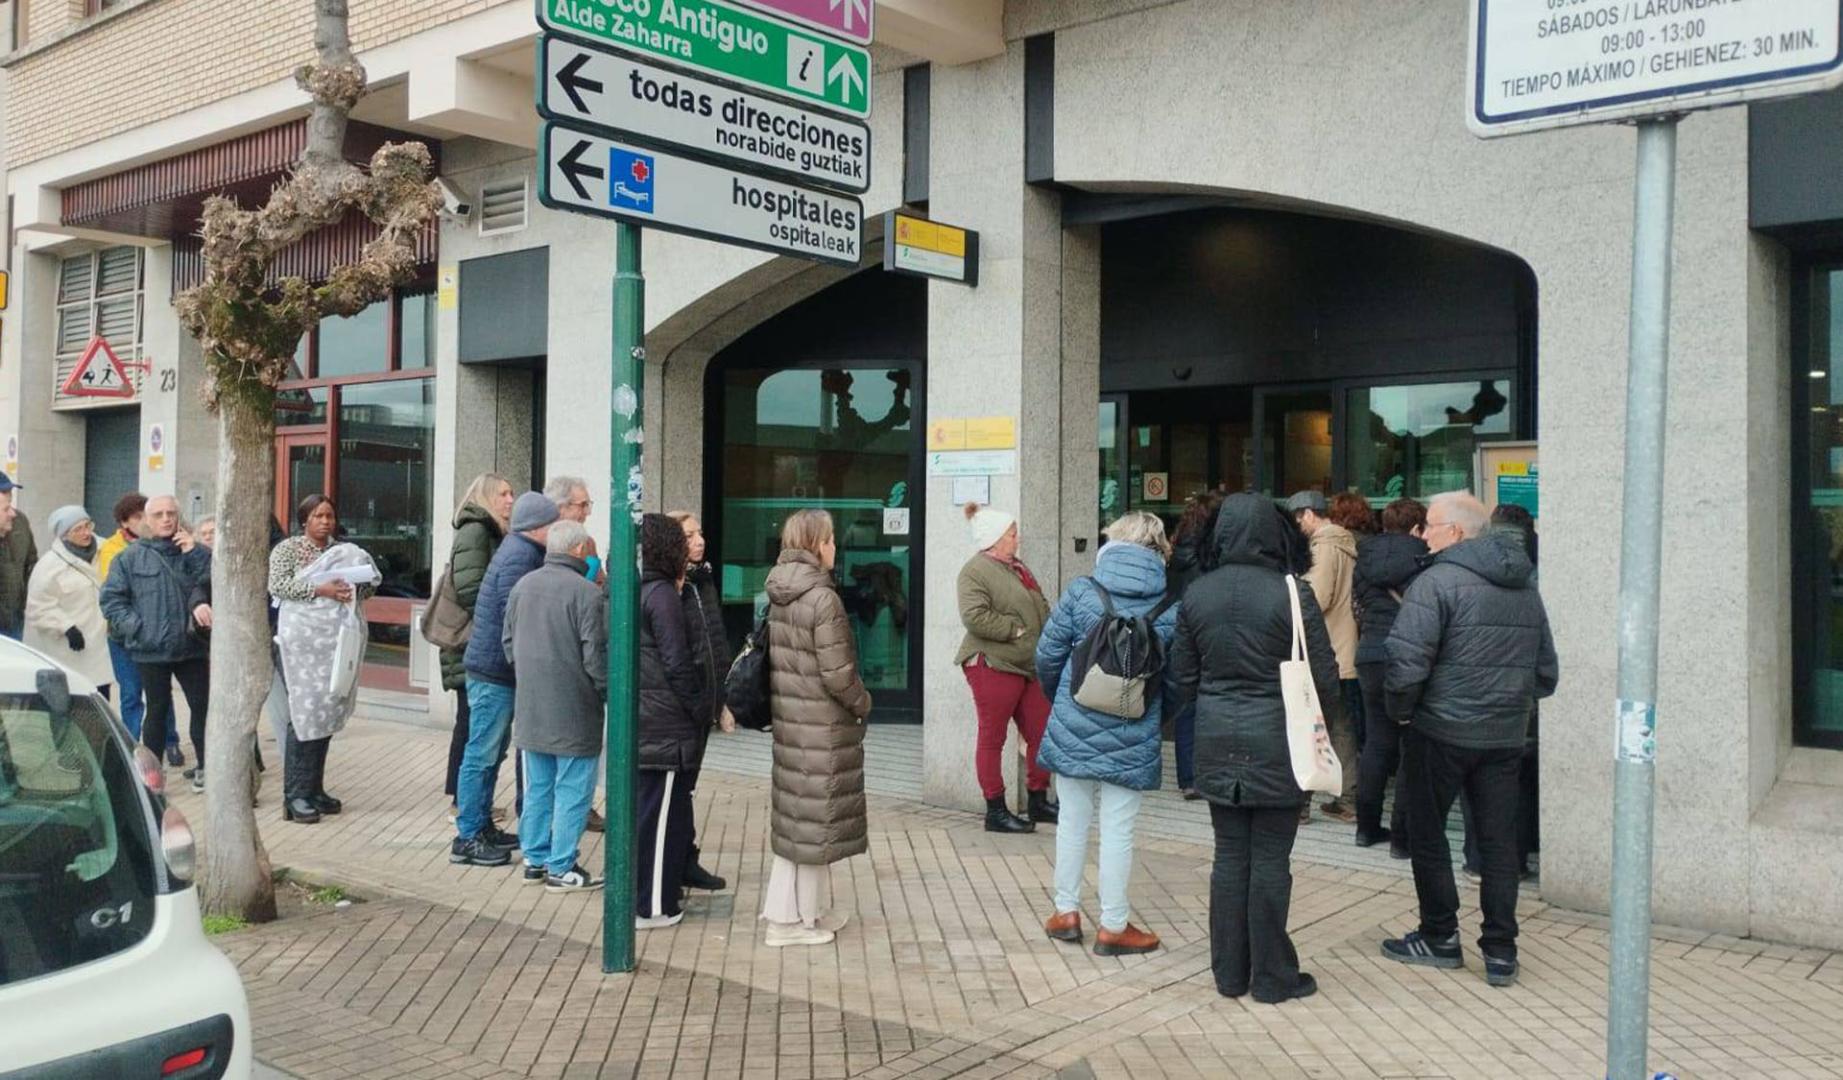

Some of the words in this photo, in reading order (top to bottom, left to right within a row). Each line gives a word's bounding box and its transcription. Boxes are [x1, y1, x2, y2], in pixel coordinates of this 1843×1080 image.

[554, 0, 607, 32] Alde
[611, 13, 693, 57] Zaharra
[659, 0, 769, 55] Antiguo
[1538, 6, 1619, 38] SÁBADOS
[1623, 3, 1630, 22] /
[1601, 29, 1645, 54] 09:00
[1661, 18, 1705, 44] 13:00
[1502, 71, 1562, 98] TIEMPO
[1566, 59, 1635, 88] MÁXIMO
[1639, 57, 1646, 76] /
[1650, 40, 1747, 73] GEHIENEZ:
[1753, 36, 1774, 57] 30
[1780, 29, 1819, 53] MIN.
[629, 68, 713, 117] todas
[722, 98, 863, 158] direcciones
[716, 125, 796, 163] norabide
[801, 147, 862, 180] guztiak
[733, 177, 856, 232] hospitales
[769, 222, 856, 256] ospitaleak
[161, 368, 176, 392] 23
[91, 900, 133, 928] C1
